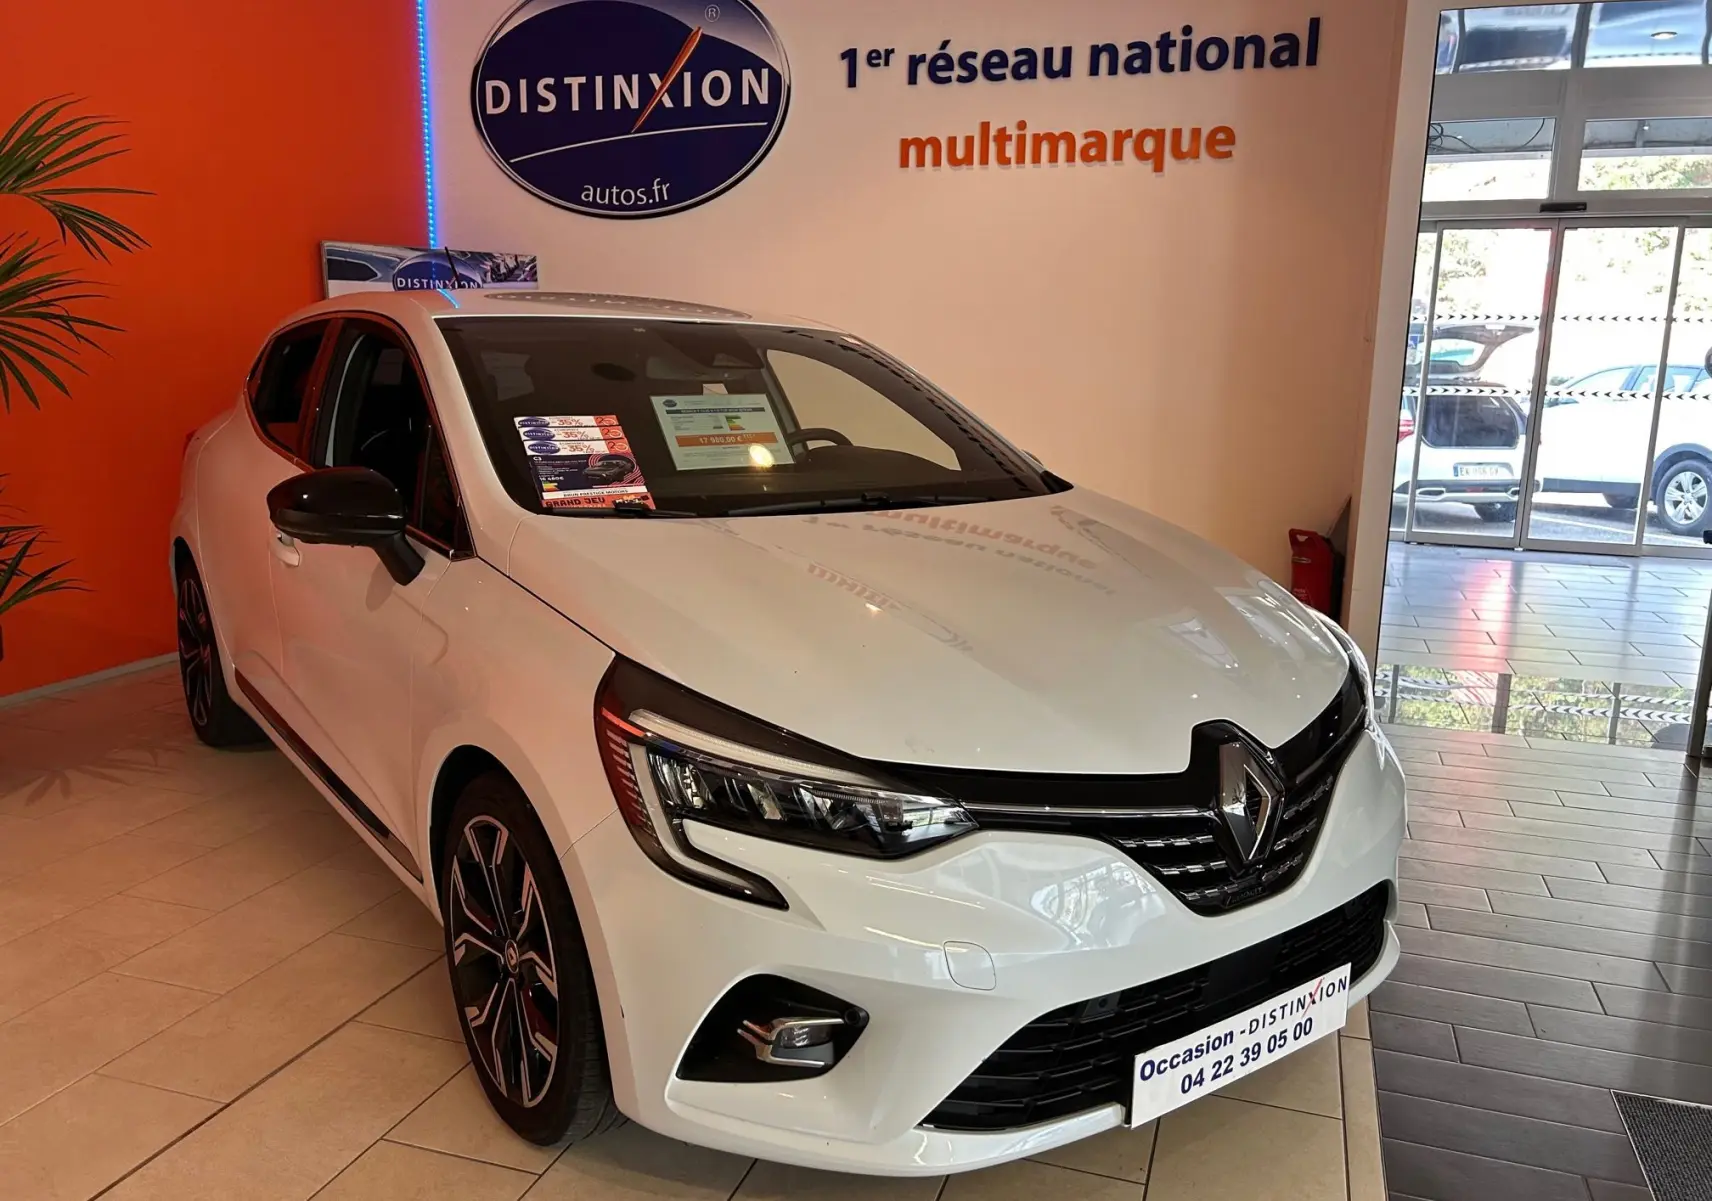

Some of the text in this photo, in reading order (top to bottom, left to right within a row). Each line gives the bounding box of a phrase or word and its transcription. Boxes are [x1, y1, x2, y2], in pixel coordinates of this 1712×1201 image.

[908, 39, 1072, 85] réseau
[1089, 17, 1321, 77] national
[485, 66, 770, 116] DISTINXION
[898, 120, 1237, 174] multimarque
[581, 178, 670, 206] autos.fr
[545, 499, 582, 507] GRAND
[1140, 1029, 1234, 1082] Occasion
[1180, 1016, 1313, 1094] 04 22 39 05 00
